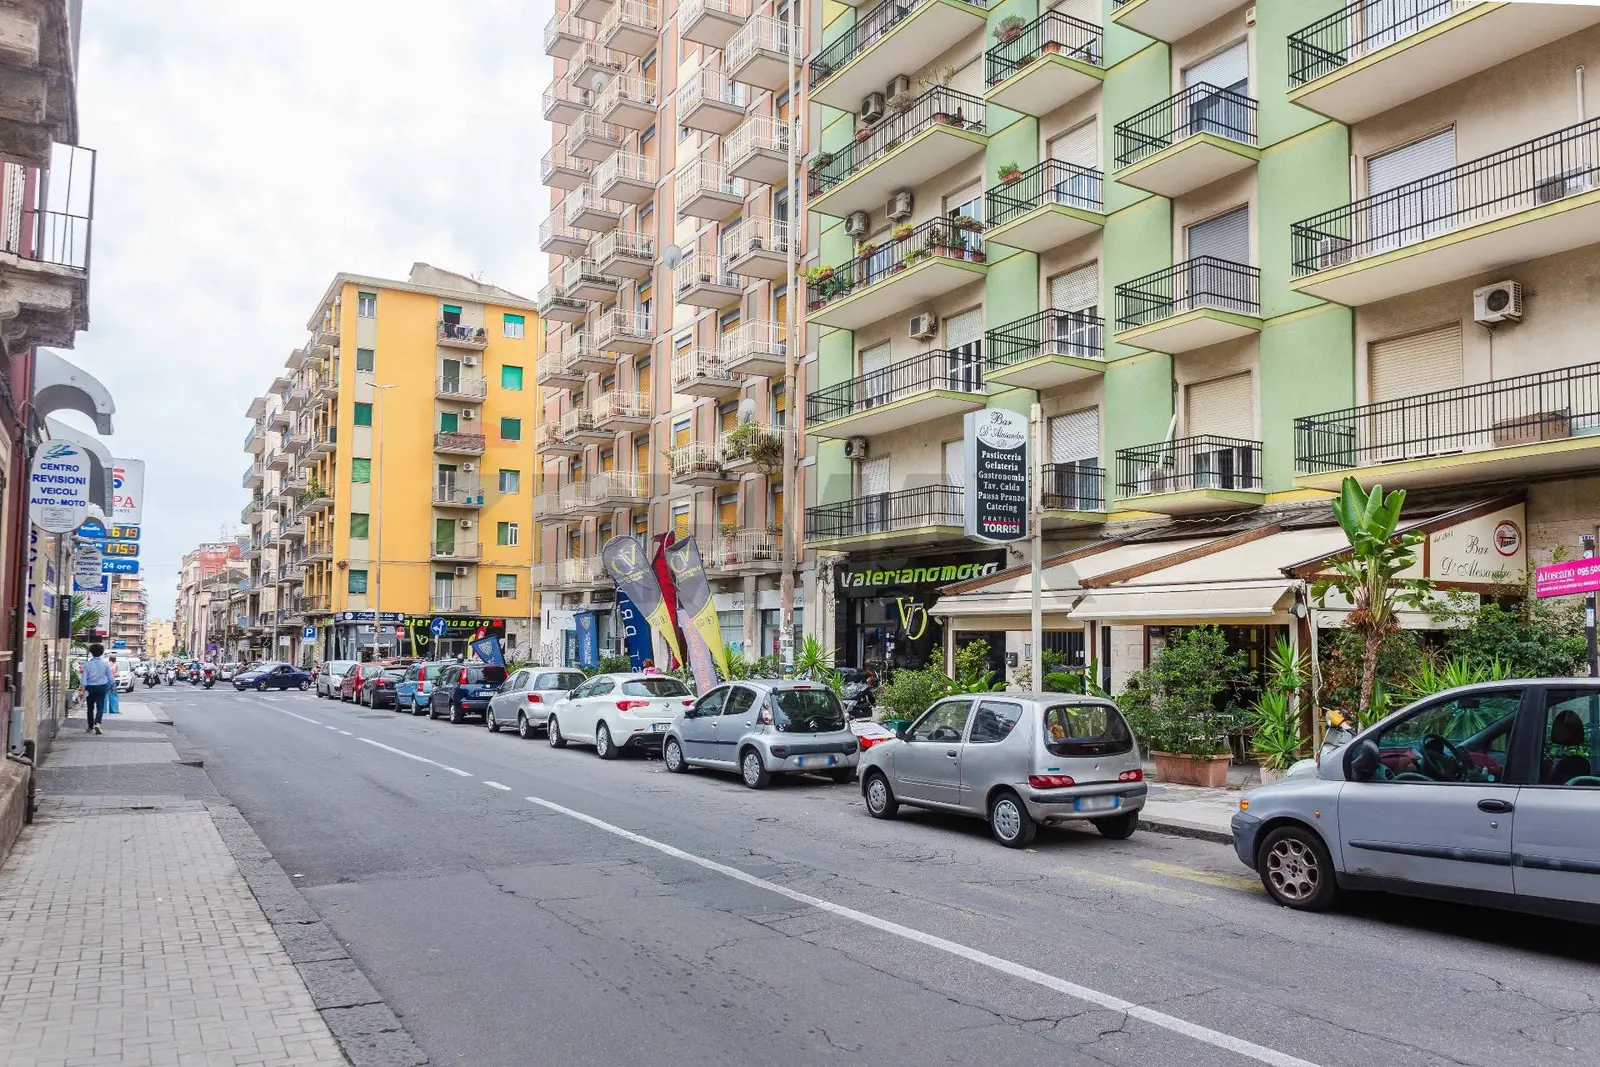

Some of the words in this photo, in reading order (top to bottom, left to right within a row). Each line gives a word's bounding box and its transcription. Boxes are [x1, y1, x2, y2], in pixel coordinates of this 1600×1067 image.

[990, 411, 1013, 426] Bar
[981, 450, 1022, 461] Pasticceria
[40, 463, 80, 473] CENTRO
[985, 461, 1019, 471] Gelateria
[32, 474, 86, 485] REVISIONI
[978, 470, 1025, 482] Gastronomia
[40, 486, 78, 496] VEICOLI
[983, 481, 999, 490] Tav.
[1000, 482, 1020, 491] Calda
[978, 491, 999, 500] Pausa
[1000, 492, 1025, 502] Pranzo
[986, 502, 1018, 513] Catering
[983, 515, 1020, 523] FRATELLI
[983, 523, 1020, 534] TORRISI
[1465, 534, 1490, 555] Bar
[306, 628, 314, 637] P
